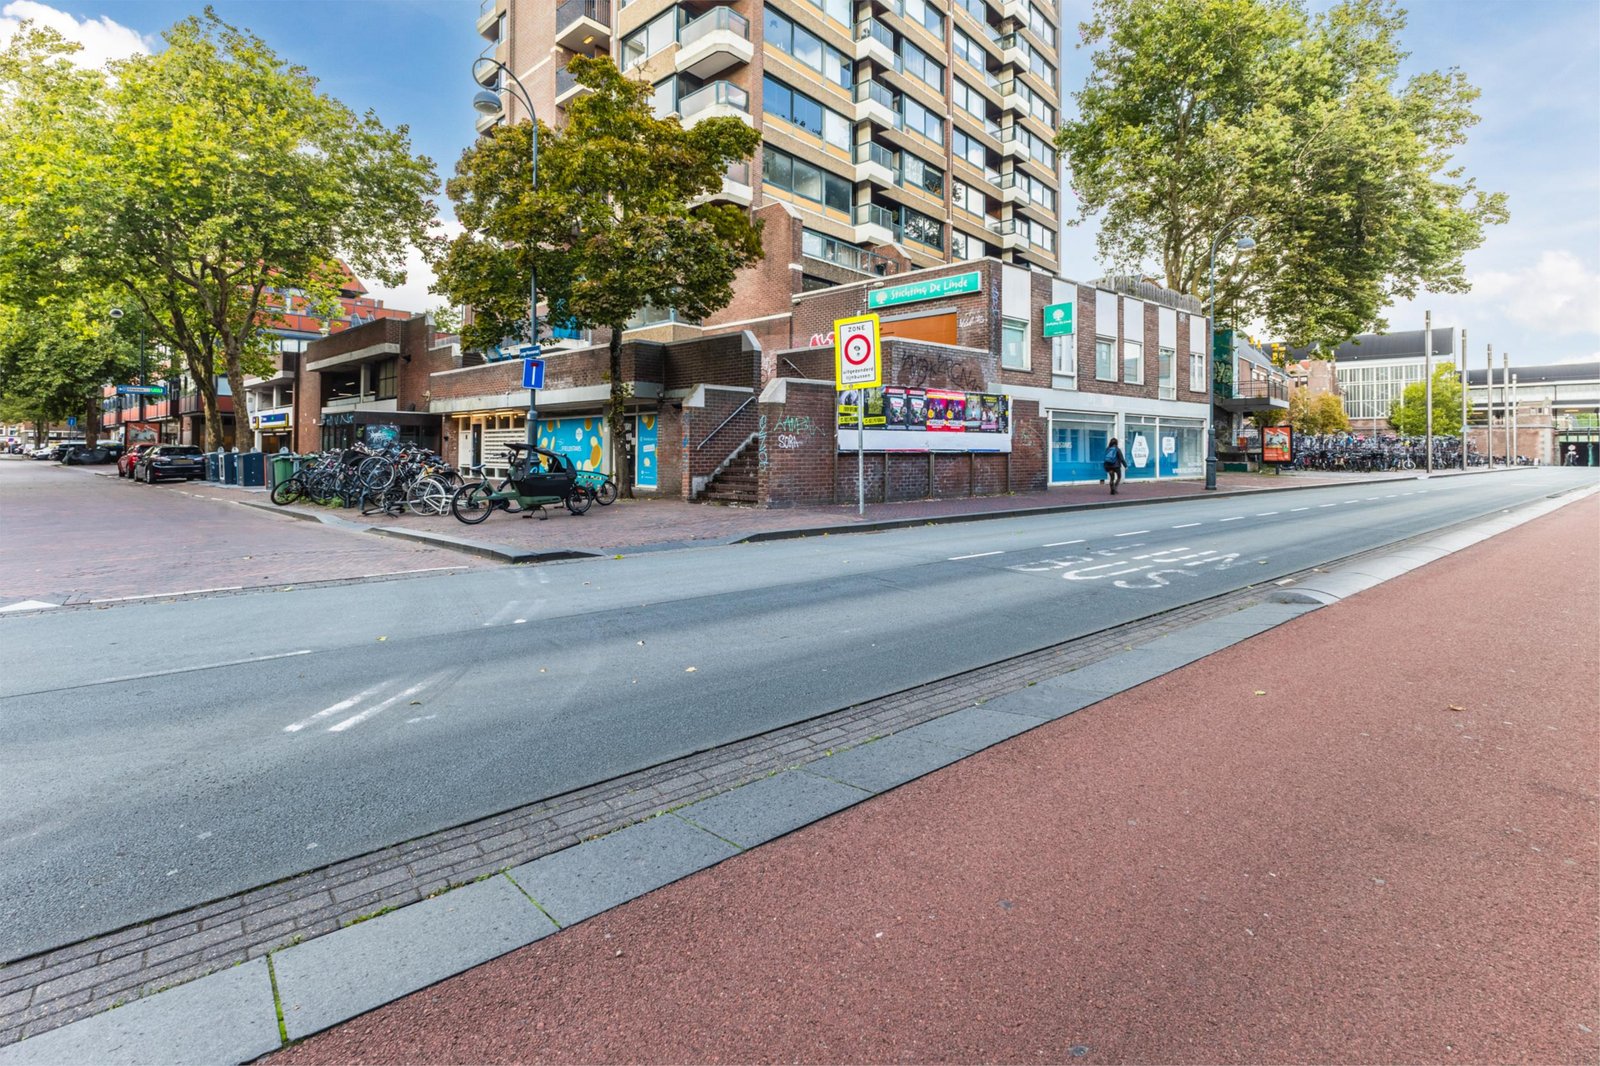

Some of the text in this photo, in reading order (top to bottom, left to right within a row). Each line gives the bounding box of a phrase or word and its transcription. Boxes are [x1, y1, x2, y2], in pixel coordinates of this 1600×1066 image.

[891, 287, 927, 300] Stichting
[930, 283, 940, 293] De
[944, 277, 968, 291] Linde
[848, 325, 865, 333] ZONE
[843, 367, 874, 375] uitgezonderd
